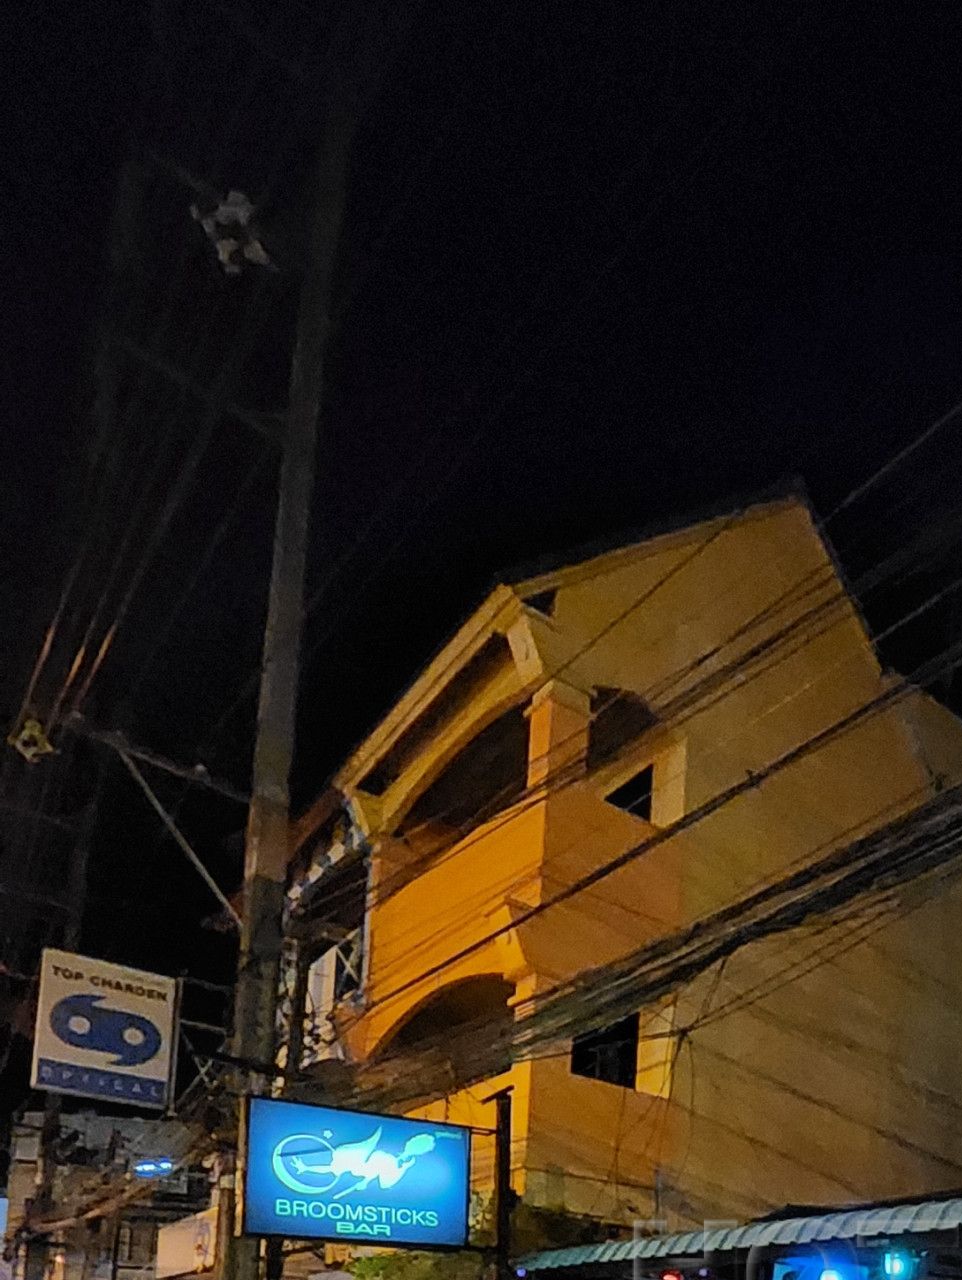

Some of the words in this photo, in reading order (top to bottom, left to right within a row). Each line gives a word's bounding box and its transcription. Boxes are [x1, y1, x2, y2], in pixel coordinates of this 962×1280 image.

[51, 964, 85, 981] TOP
[275, 1198, 440, 1228] BROOMSTICKS
[335, 1221, 392, 1237] BAR
